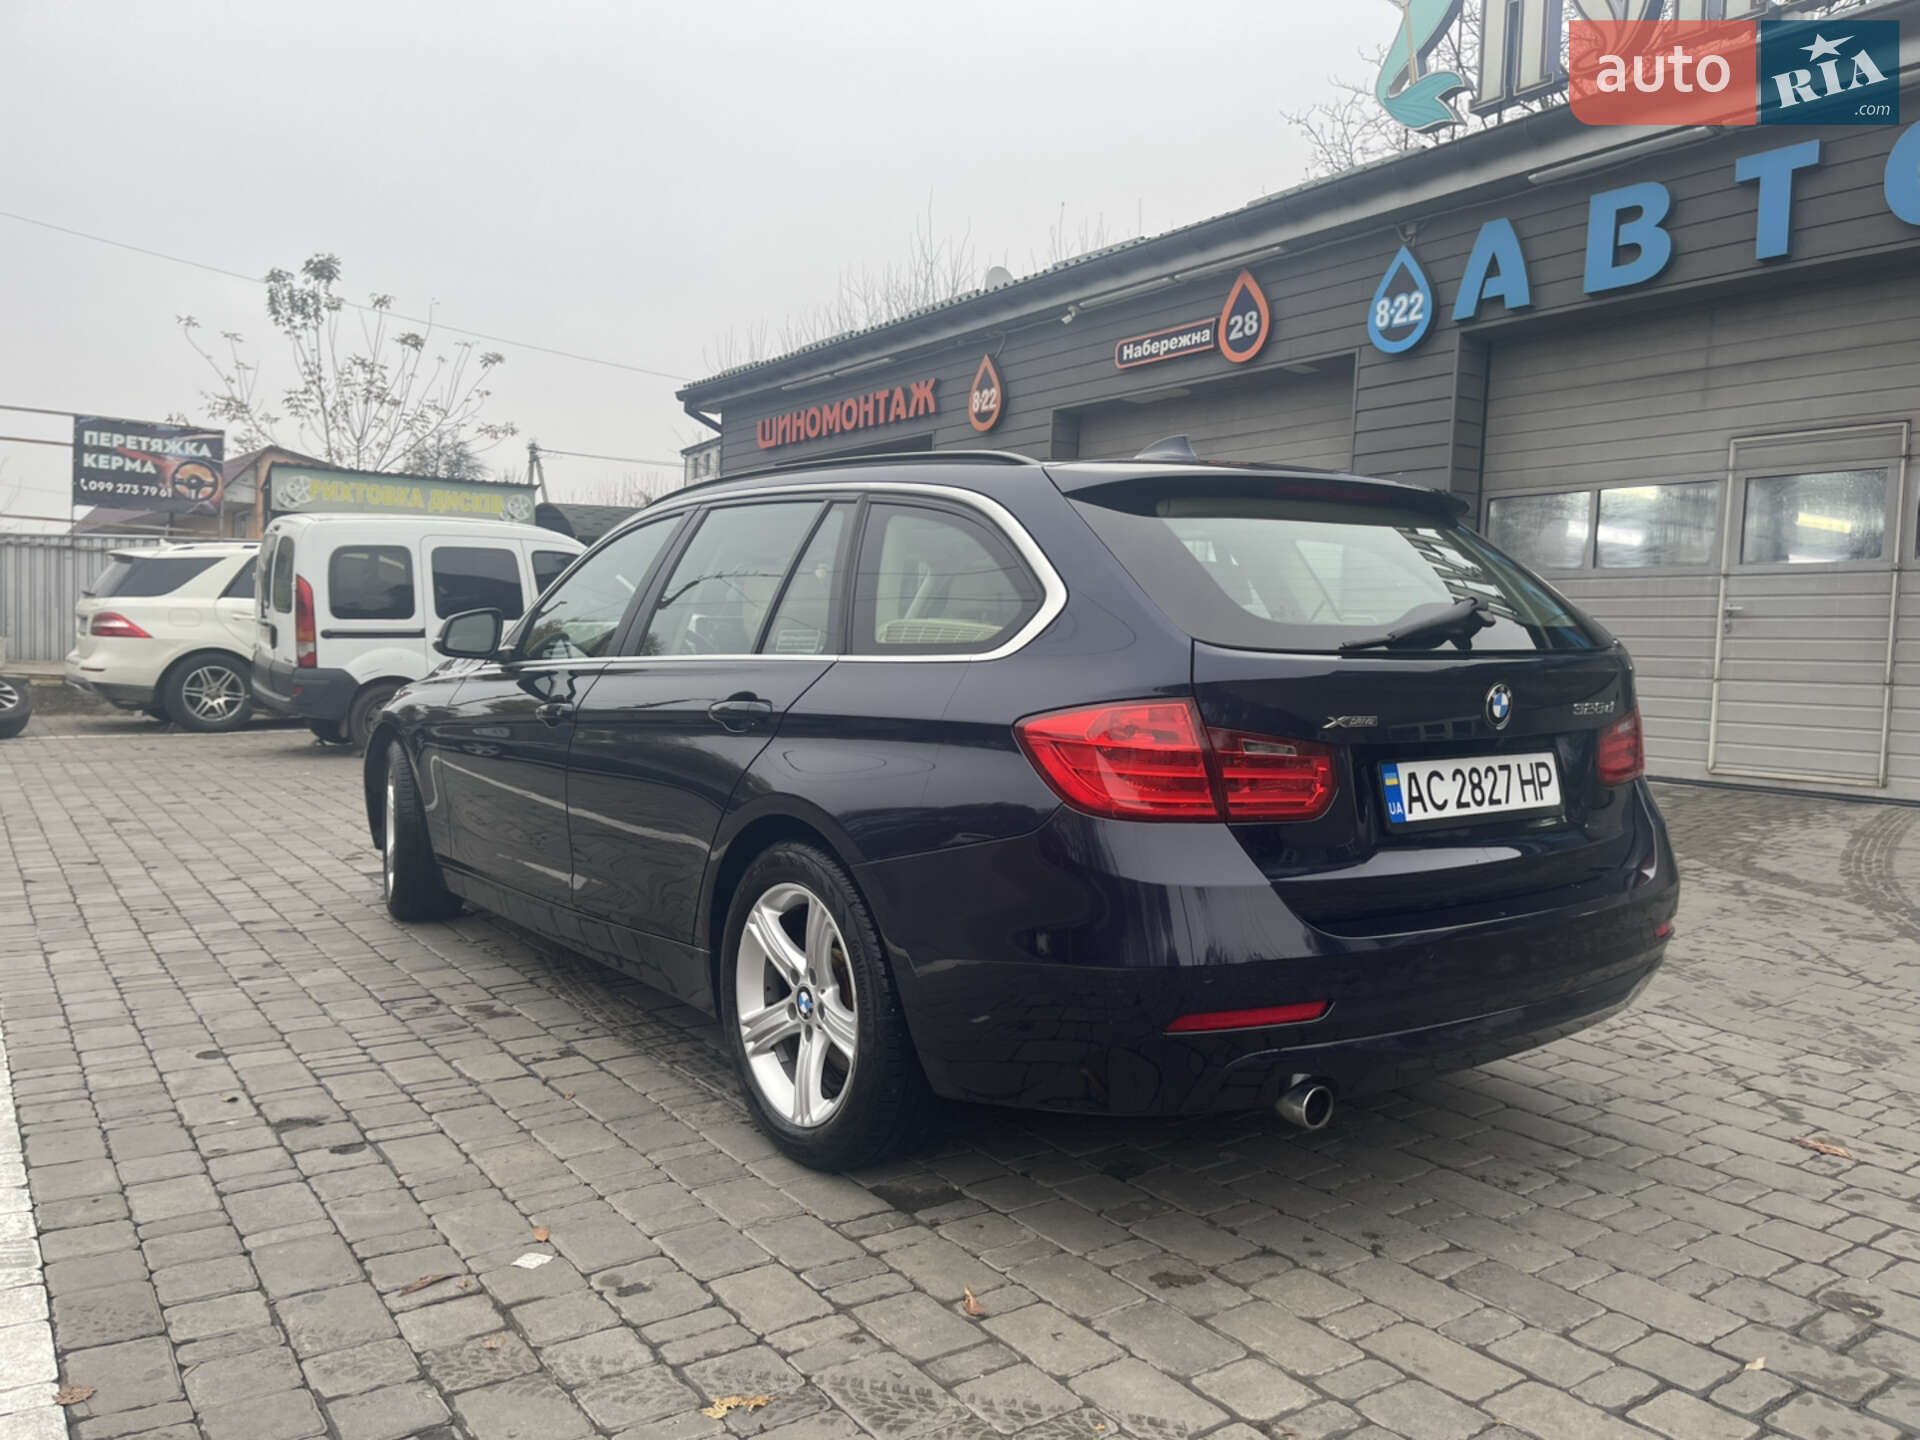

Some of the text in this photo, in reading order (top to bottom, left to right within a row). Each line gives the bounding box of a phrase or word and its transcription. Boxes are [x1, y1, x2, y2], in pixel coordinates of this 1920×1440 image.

[1122, 311, 1259, 361] Набережна 28
[756, 378, 936, 449] ШИНОМОНТАЖ
[83, 430, 213, 458] ПЕРЕТЯЖКА
[83, 453, 157, 474] КЕРМА
[308, 478, 424, 509] РИХТОВКА
[1407, 761, 1552, 815] AC 2827 HP
[1388, 801, 1403, 815] UA
